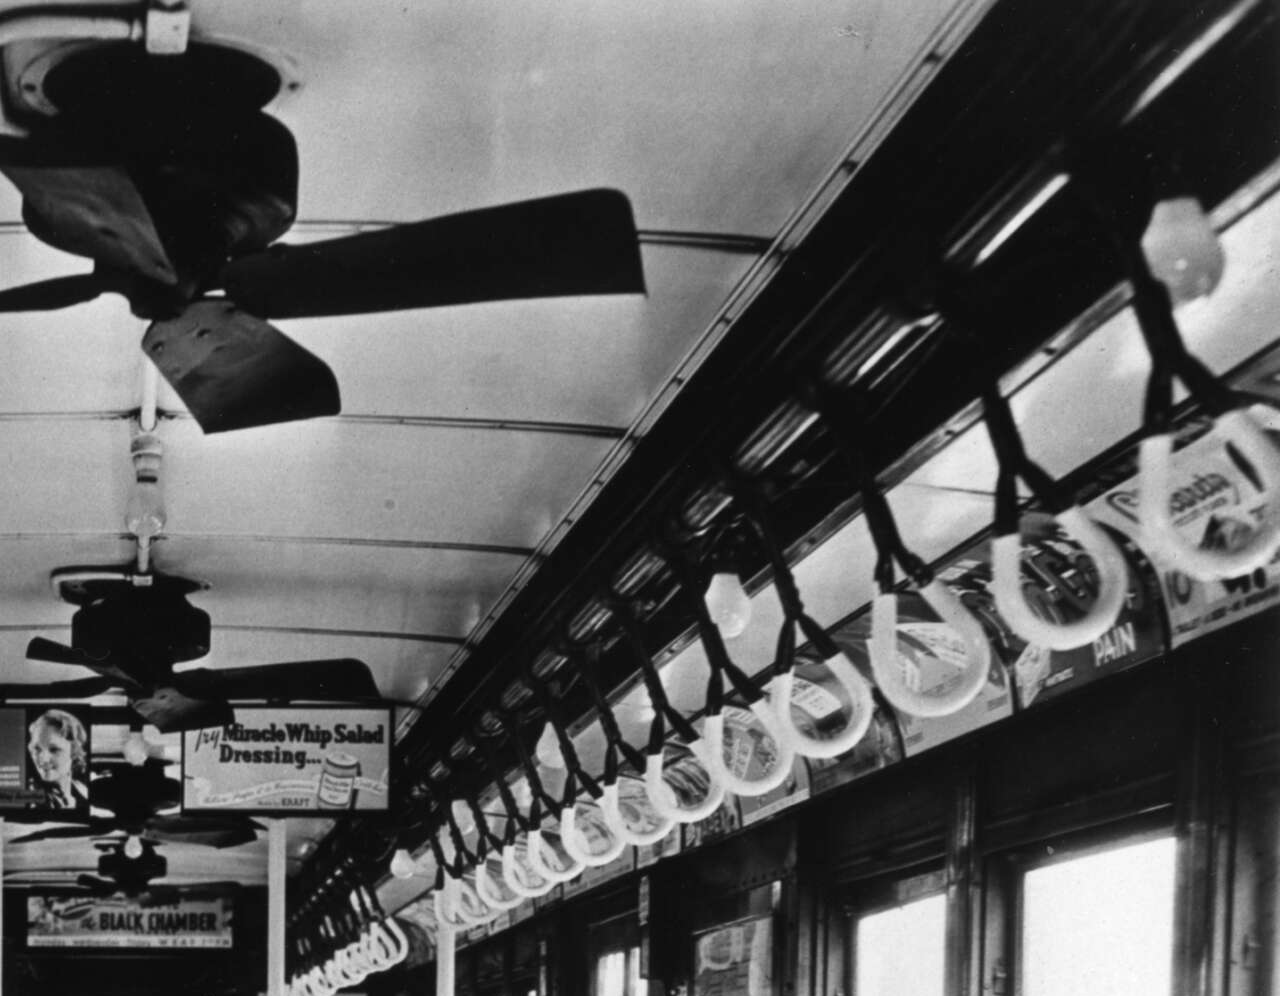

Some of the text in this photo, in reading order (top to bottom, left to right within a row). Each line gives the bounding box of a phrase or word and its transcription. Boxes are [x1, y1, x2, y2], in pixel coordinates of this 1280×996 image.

[1092, 621, 1136, 667] PAIN
[222, 722, 286, 743] Miracle
[285, 722, 333, 750] Whip
[334, 724, 384, 744] Salad
[219, 744, 322, 769] Dressing...
[281, 797, 310, 807] KRAFT
[99, 912, 144, 932] BLACK
[148, 912, 218, 933] CHAMBER
